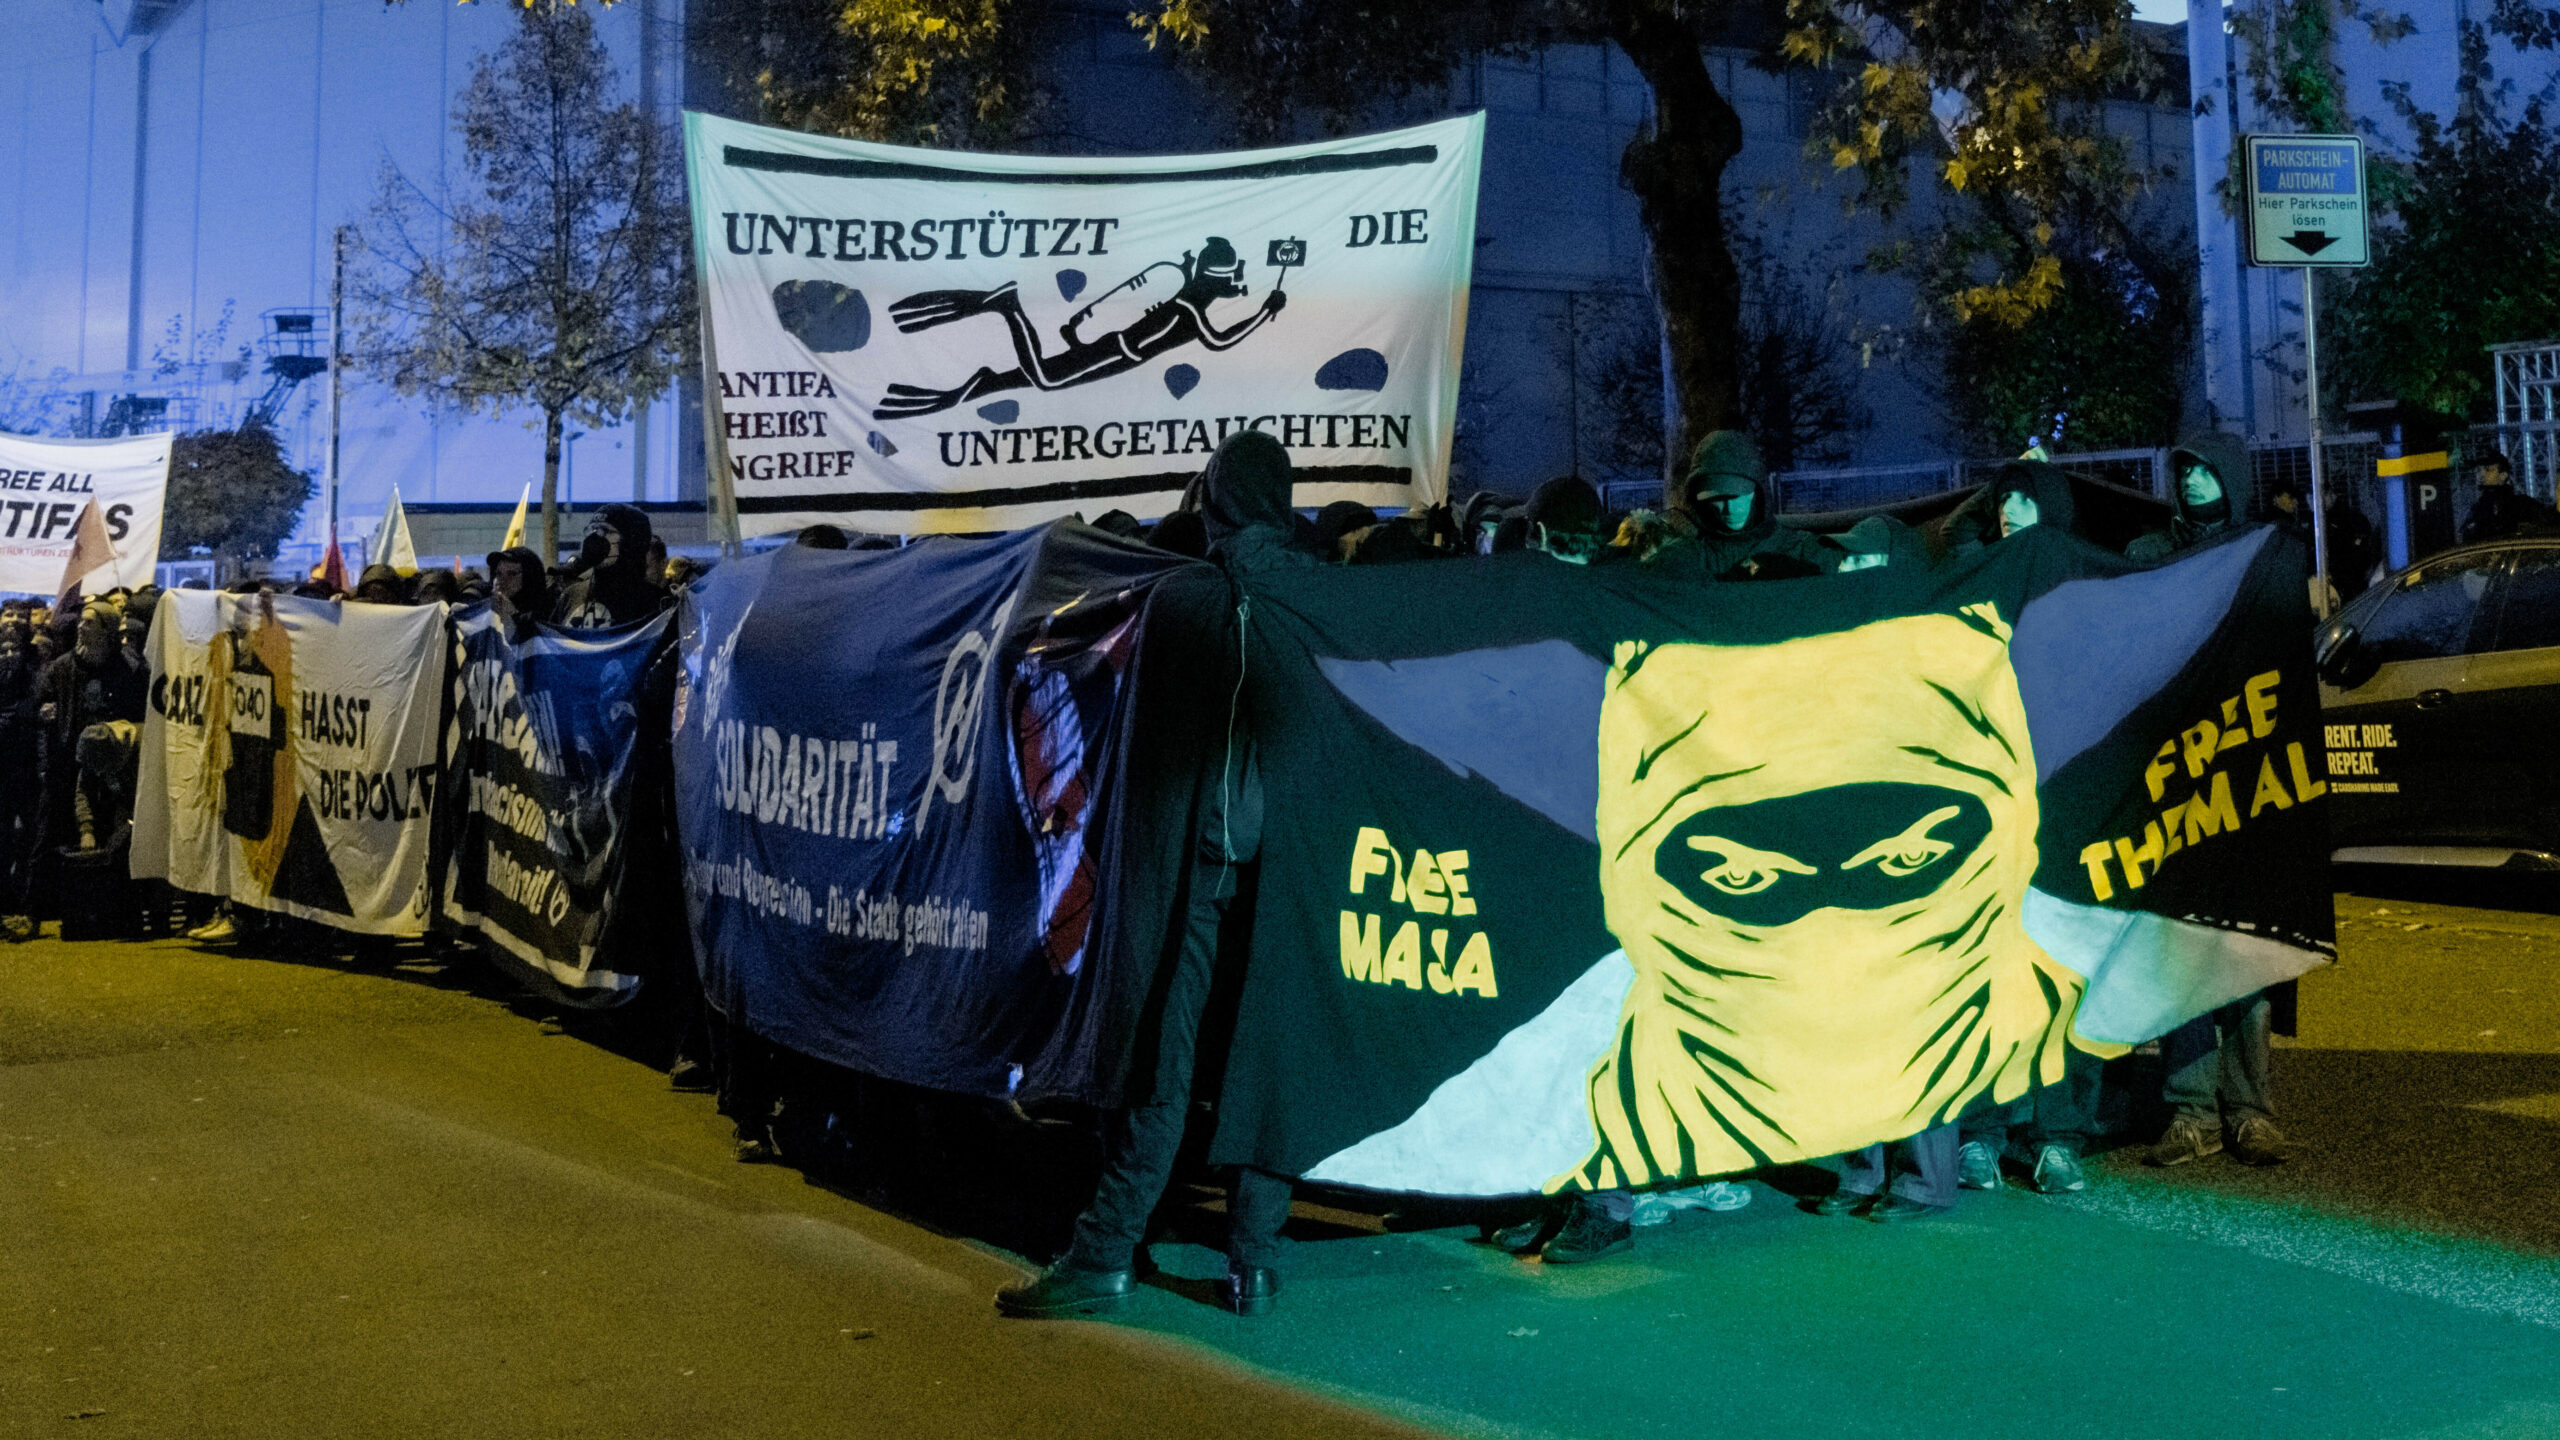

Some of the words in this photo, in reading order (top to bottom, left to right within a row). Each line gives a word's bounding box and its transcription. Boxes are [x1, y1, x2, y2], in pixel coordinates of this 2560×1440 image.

[2263, 149, 2349, 167] PARKSCHEIN-
[2278, 172, 2337, 190] AUTOMAT
[2258, 197, 2284, 209] Hier
[2290, 197, 2358, 210] Parkschein
[2292, 213, 2326, 226] lösen
[722, 210, 1119, 262] UNTERSTÜTZT
[1345, 209, 1428, 248] DIE
[718, 371, 838, 399] ANTIFA
[47, 472, 94, 494] ALL
[2419, 484, 2438, 511] P
[302, 690, 371, 750] HASST
[2144, 669, 2281, 803] FREE
[2324, 724, 2361, 749] RENT.
[2361, 723, 2398, 748] RIDE.
[2326, 751, 2380, 775] REPEAT.
[716, 717, 898, 840] SOLIDARITÄT
[320, 769, 351, 820] DIE
[2079, 770, 2241, 902] THEM
[826, 884, 851, 936] Die
[856, 888, 900, 941] Stadt
[1340, 909, 1498, 998] MAJA
